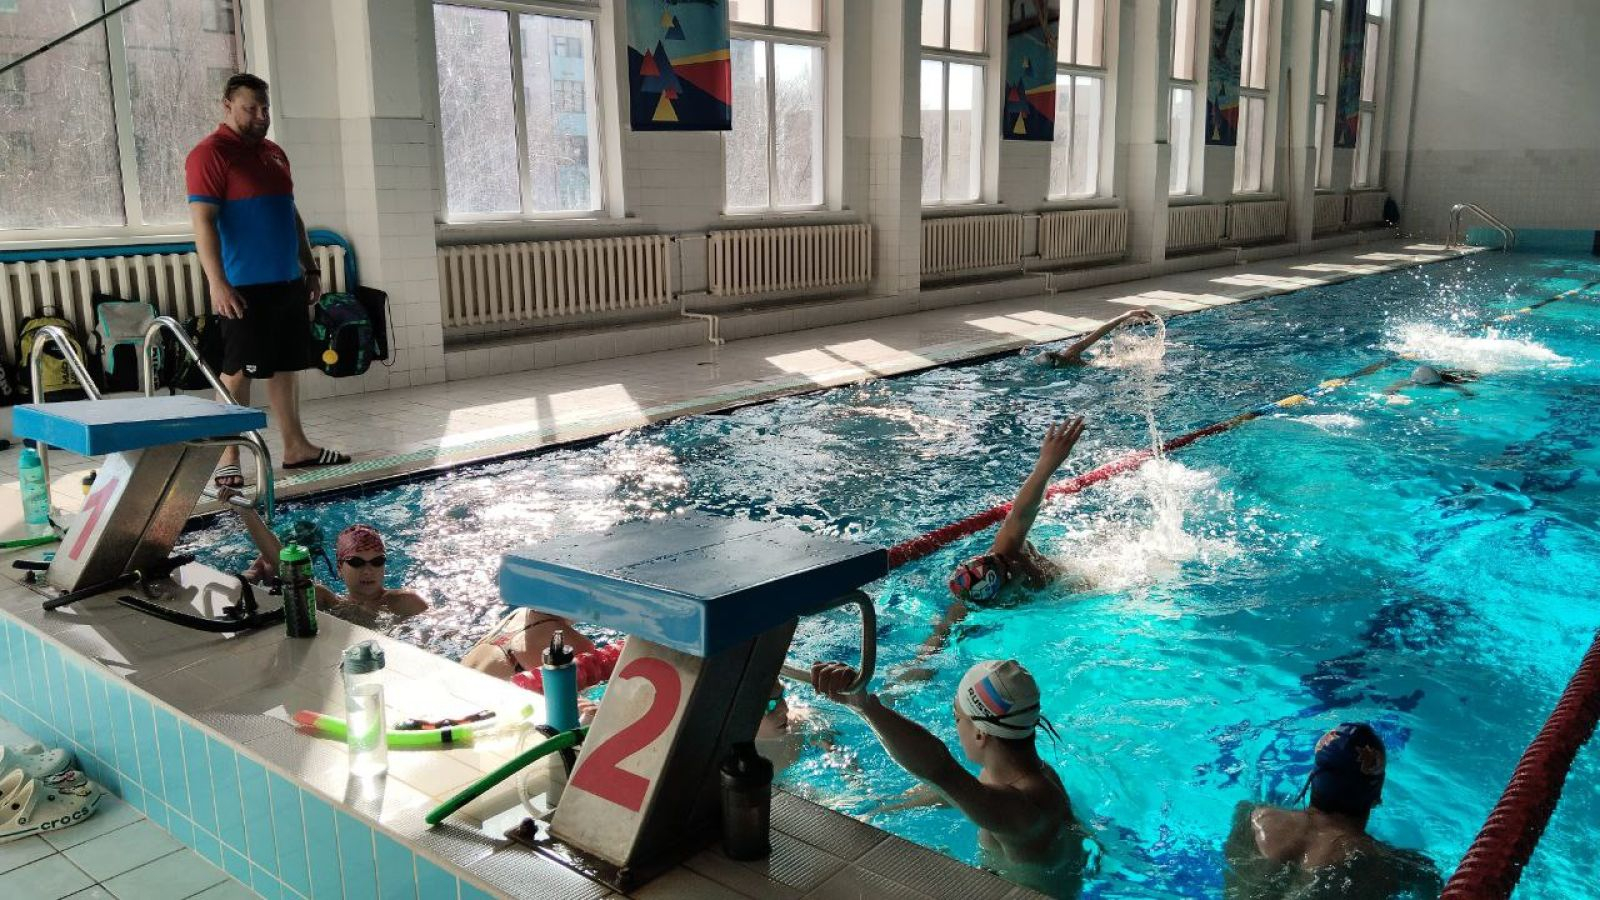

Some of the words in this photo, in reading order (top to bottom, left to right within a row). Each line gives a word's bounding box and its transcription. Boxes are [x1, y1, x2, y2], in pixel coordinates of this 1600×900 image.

[69, 478, 119, 560] 1
[968, 687, 994, 718] RUSS
[571, 657, 681, 812] 2
[41, 806, 89, 830] crocs
